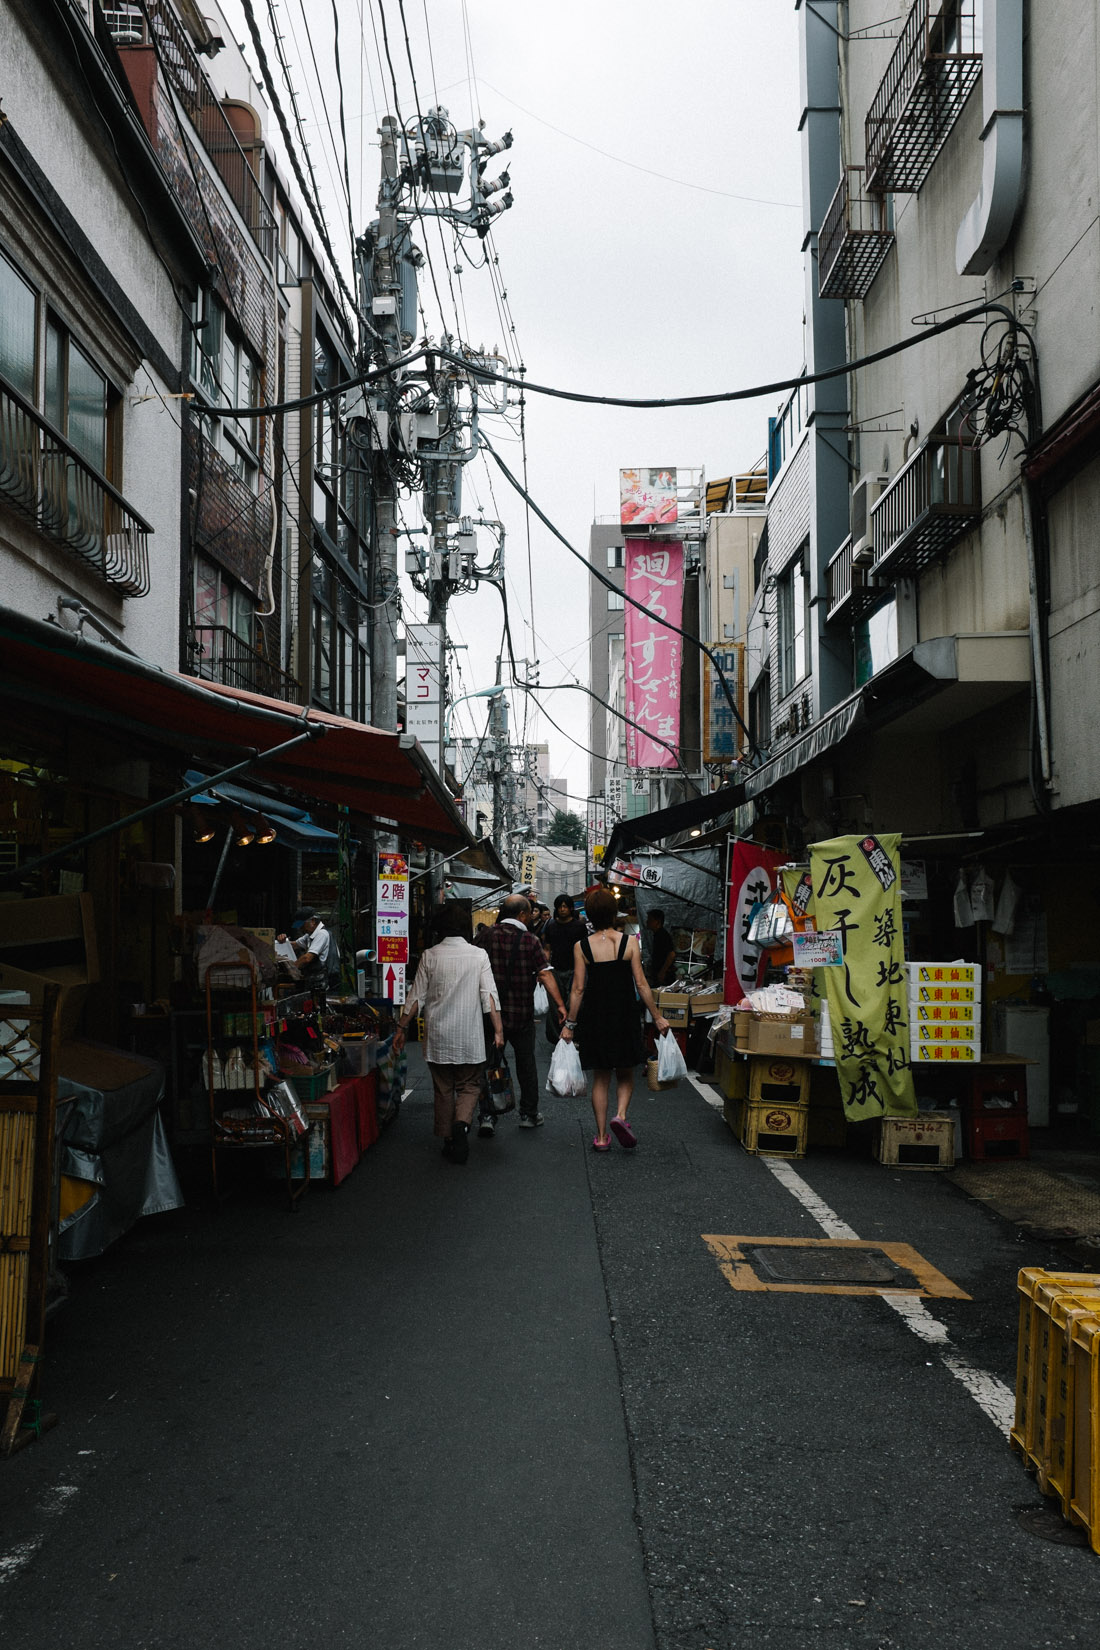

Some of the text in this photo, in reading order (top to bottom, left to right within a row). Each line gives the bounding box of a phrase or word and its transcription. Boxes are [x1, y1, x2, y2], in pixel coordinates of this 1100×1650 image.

[416, 668, 430, 698] マコ
[872, 908, 912, 1076] 築地東仙
